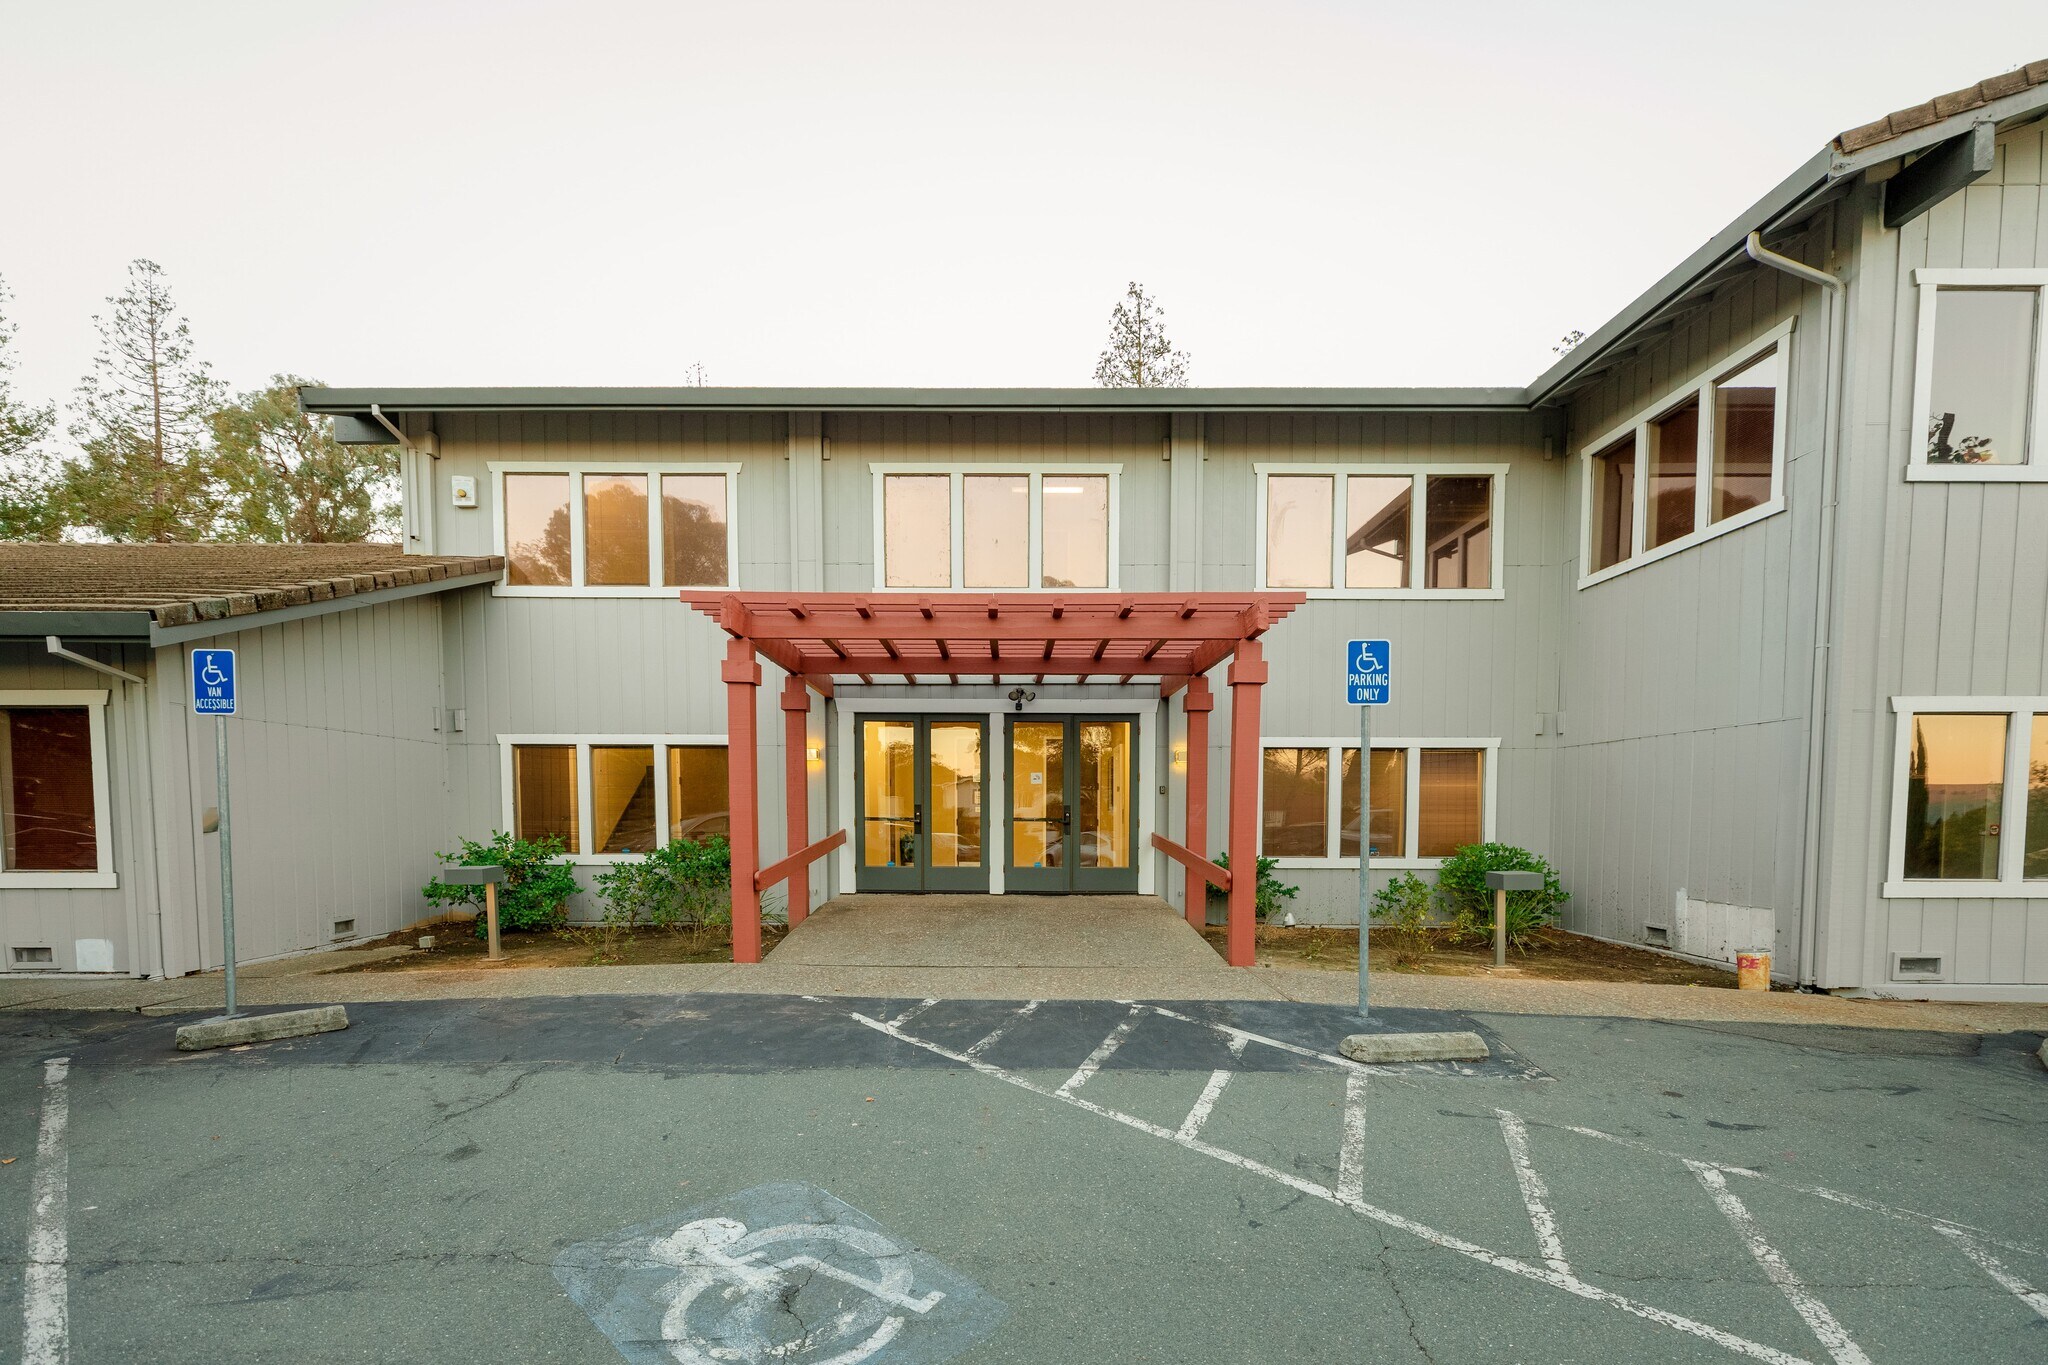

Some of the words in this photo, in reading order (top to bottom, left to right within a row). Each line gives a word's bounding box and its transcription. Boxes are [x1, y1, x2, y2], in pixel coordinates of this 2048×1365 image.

[1349, 673, 1388, 686] PARKING
[207, 686, 222, 697] VAN
[1356, 688, 1380, 701] ONLY
[196, 698, 234, 709] ACCESSIBLE
